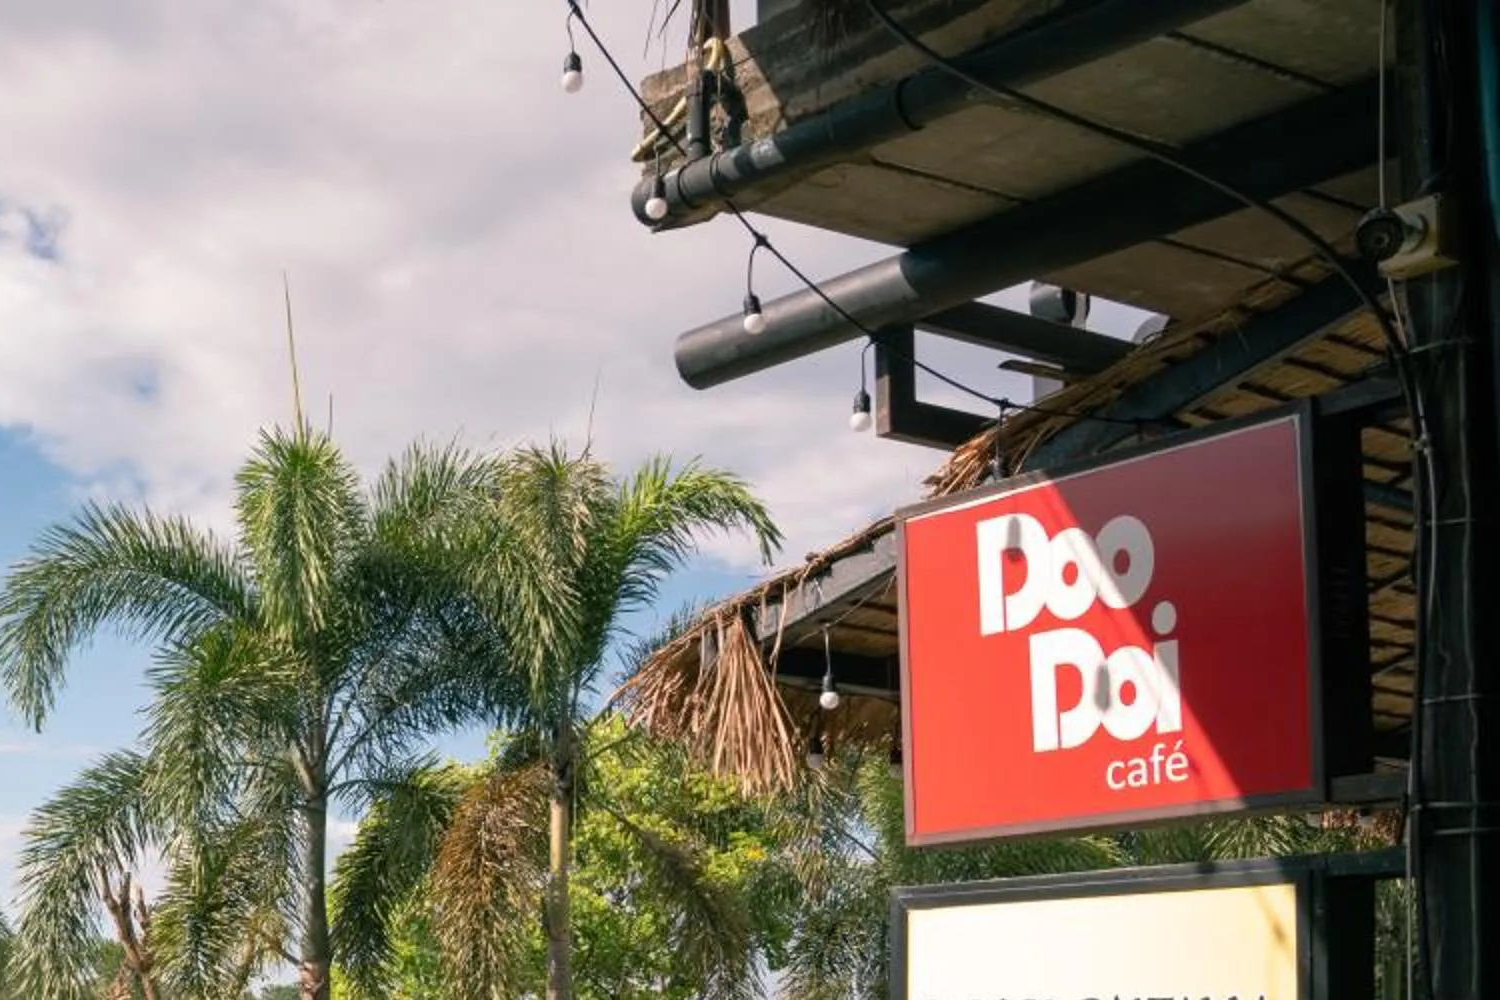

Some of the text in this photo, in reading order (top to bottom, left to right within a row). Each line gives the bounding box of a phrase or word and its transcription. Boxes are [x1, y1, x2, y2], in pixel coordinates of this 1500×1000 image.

[976, 513, 1155, 636] Doo
[1029, 601, 1183, 752] Doi
[1106, 743, 1190, 790] café
